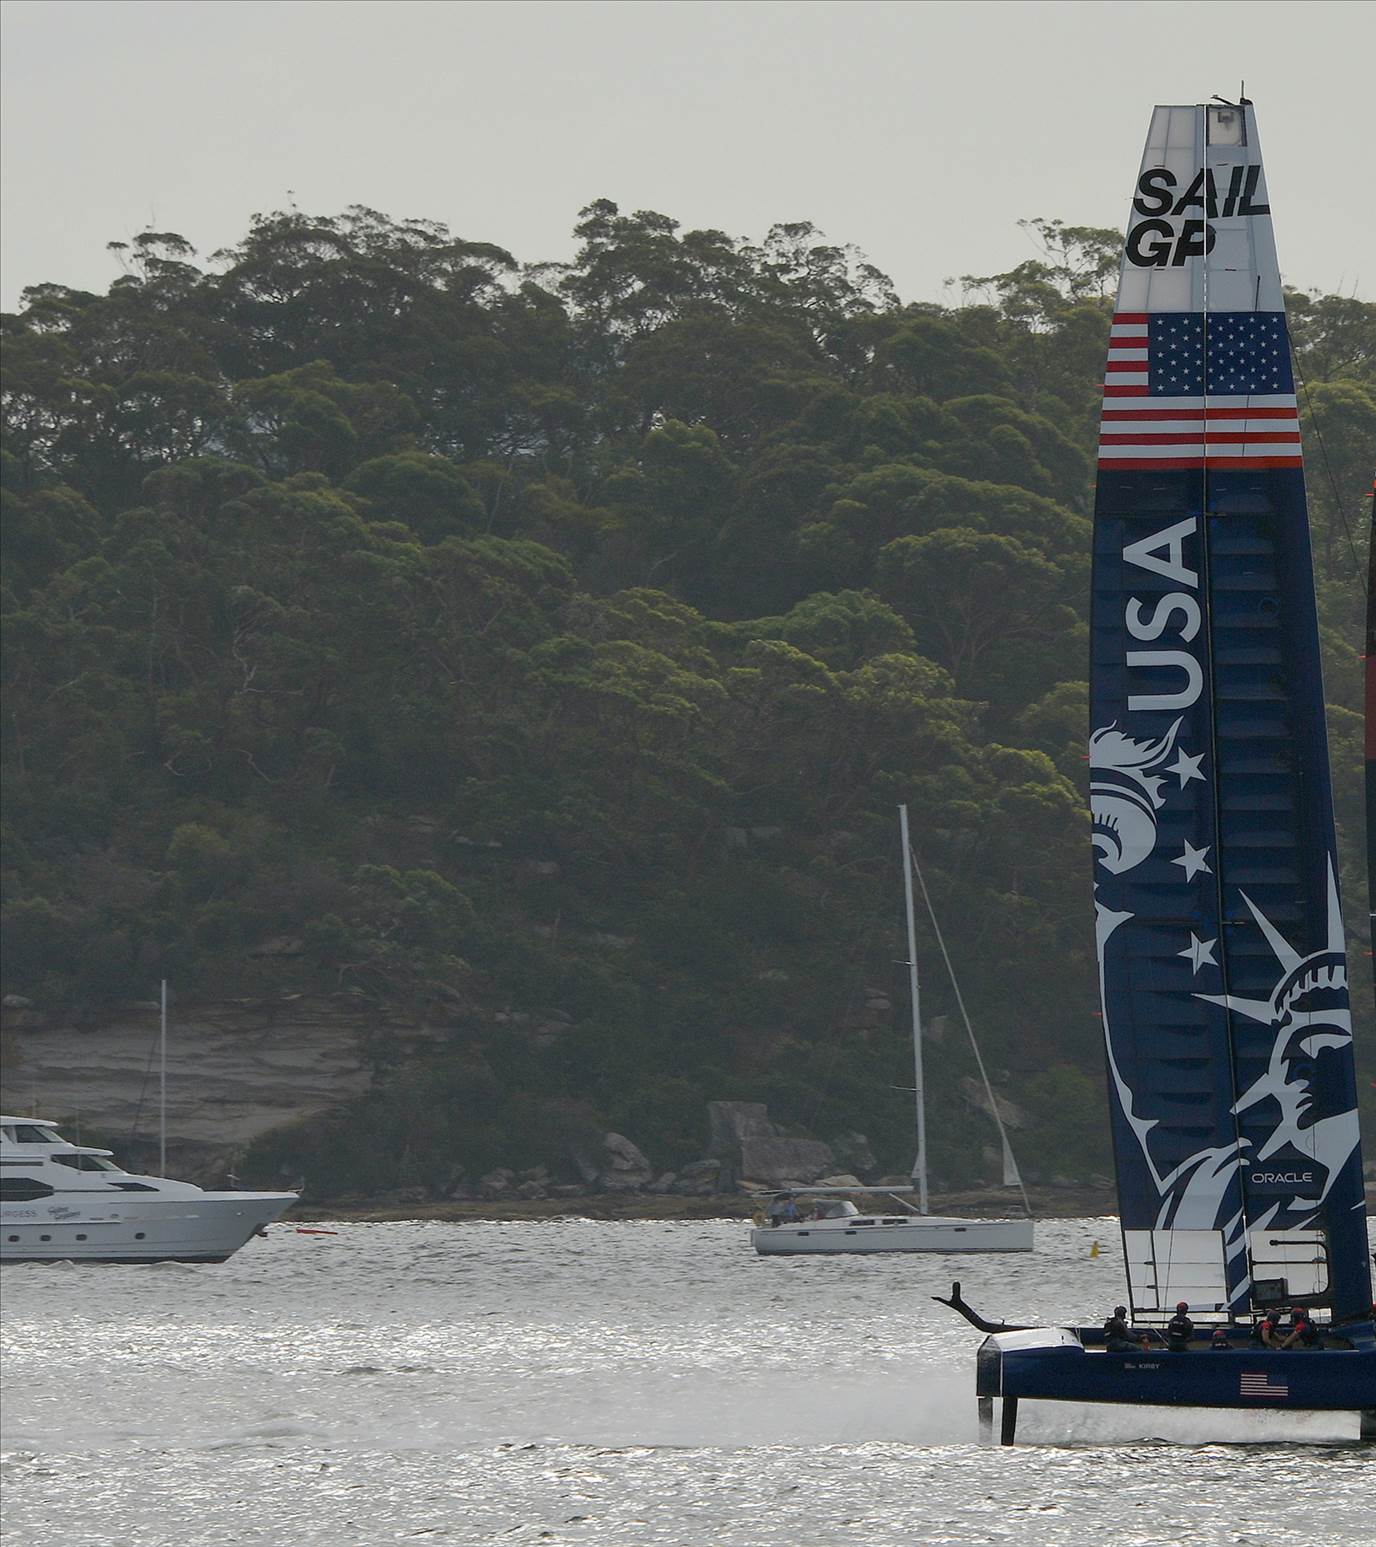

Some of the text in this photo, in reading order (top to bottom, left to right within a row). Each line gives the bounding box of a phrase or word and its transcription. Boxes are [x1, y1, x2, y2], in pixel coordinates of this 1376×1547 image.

[1133, 165, 1271, 219] SAIL
[1125, 219, 1217, 268] GP
[1122, 516, 1204, 711] USA
[1251, 1172, 1313, 1184] ORACLE
